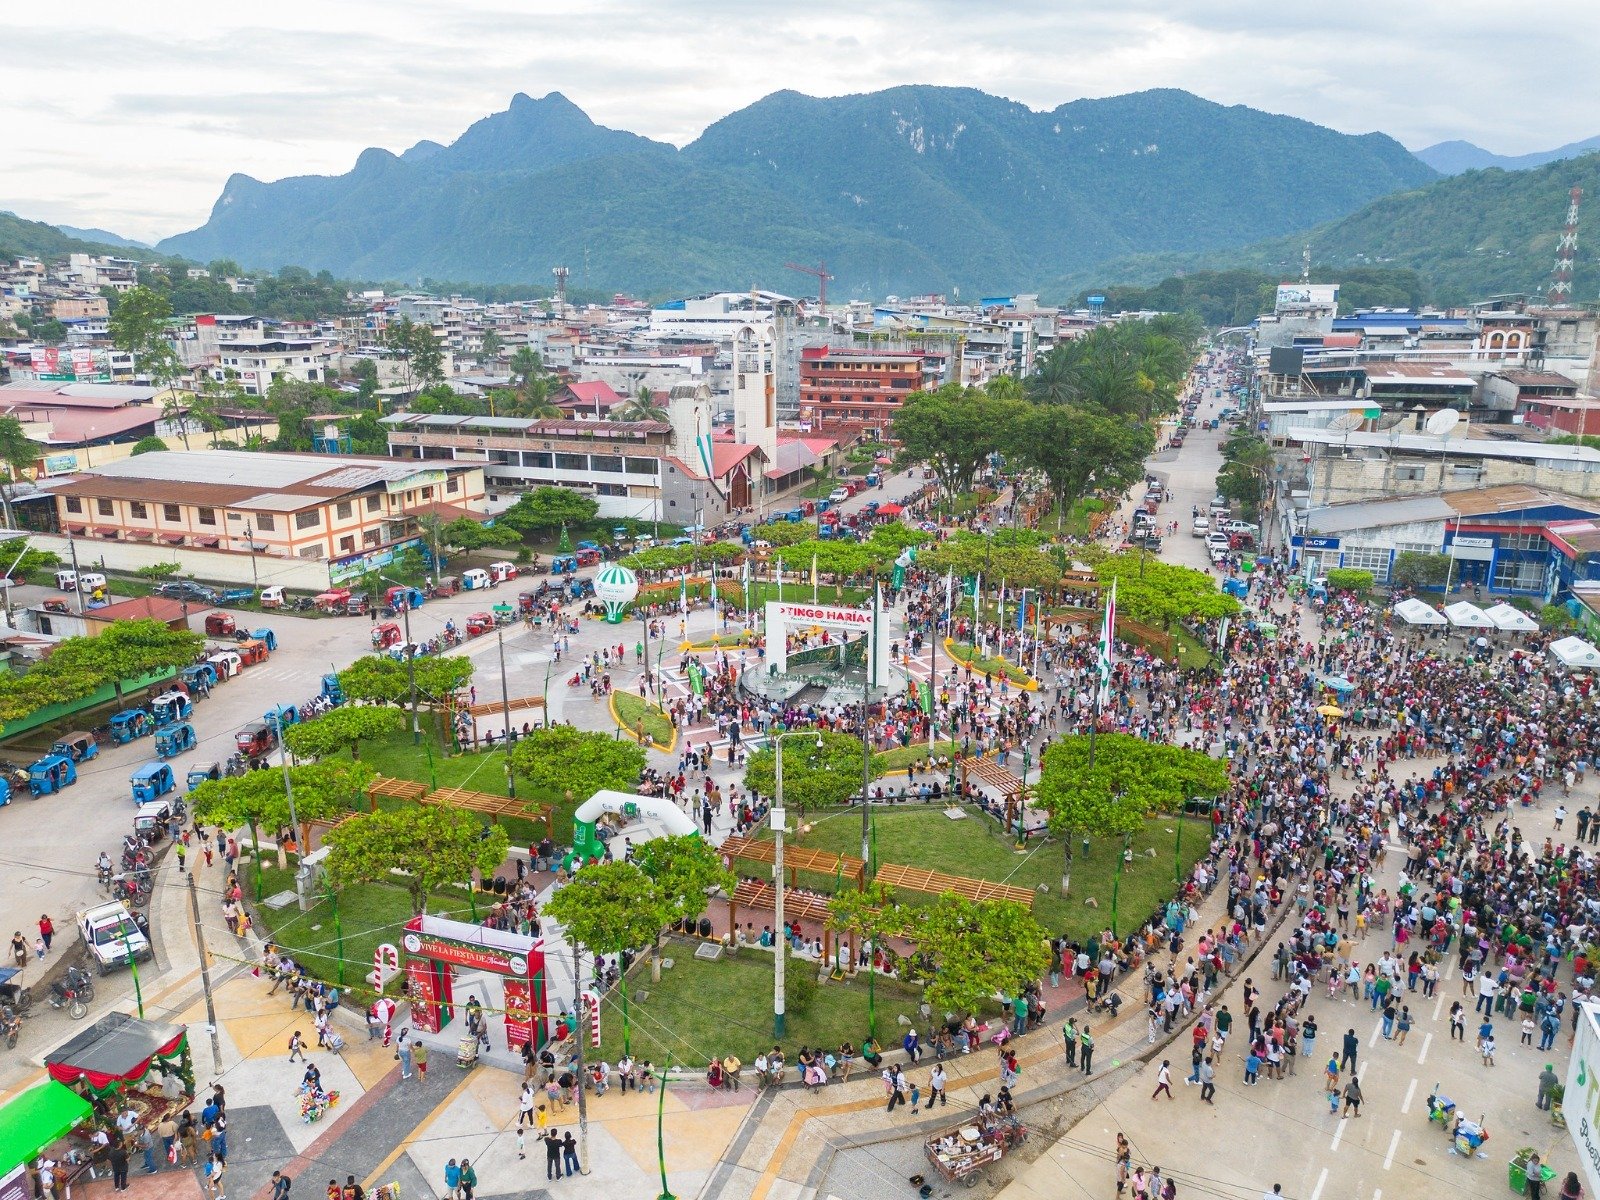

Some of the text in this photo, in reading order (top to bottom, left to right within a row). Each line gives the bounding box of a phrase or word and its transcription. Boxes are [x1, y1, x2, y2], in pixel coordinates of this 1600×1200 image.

[786, 606, 824, 619] TINGO
[420, 942, 437, 953] VIVE
[438, 947, 449, 956] LA
[449, 949, 475, 960] FIESTA
[476, 954, 487, 963] DE
[487, 956, 509, 967] Navidad
